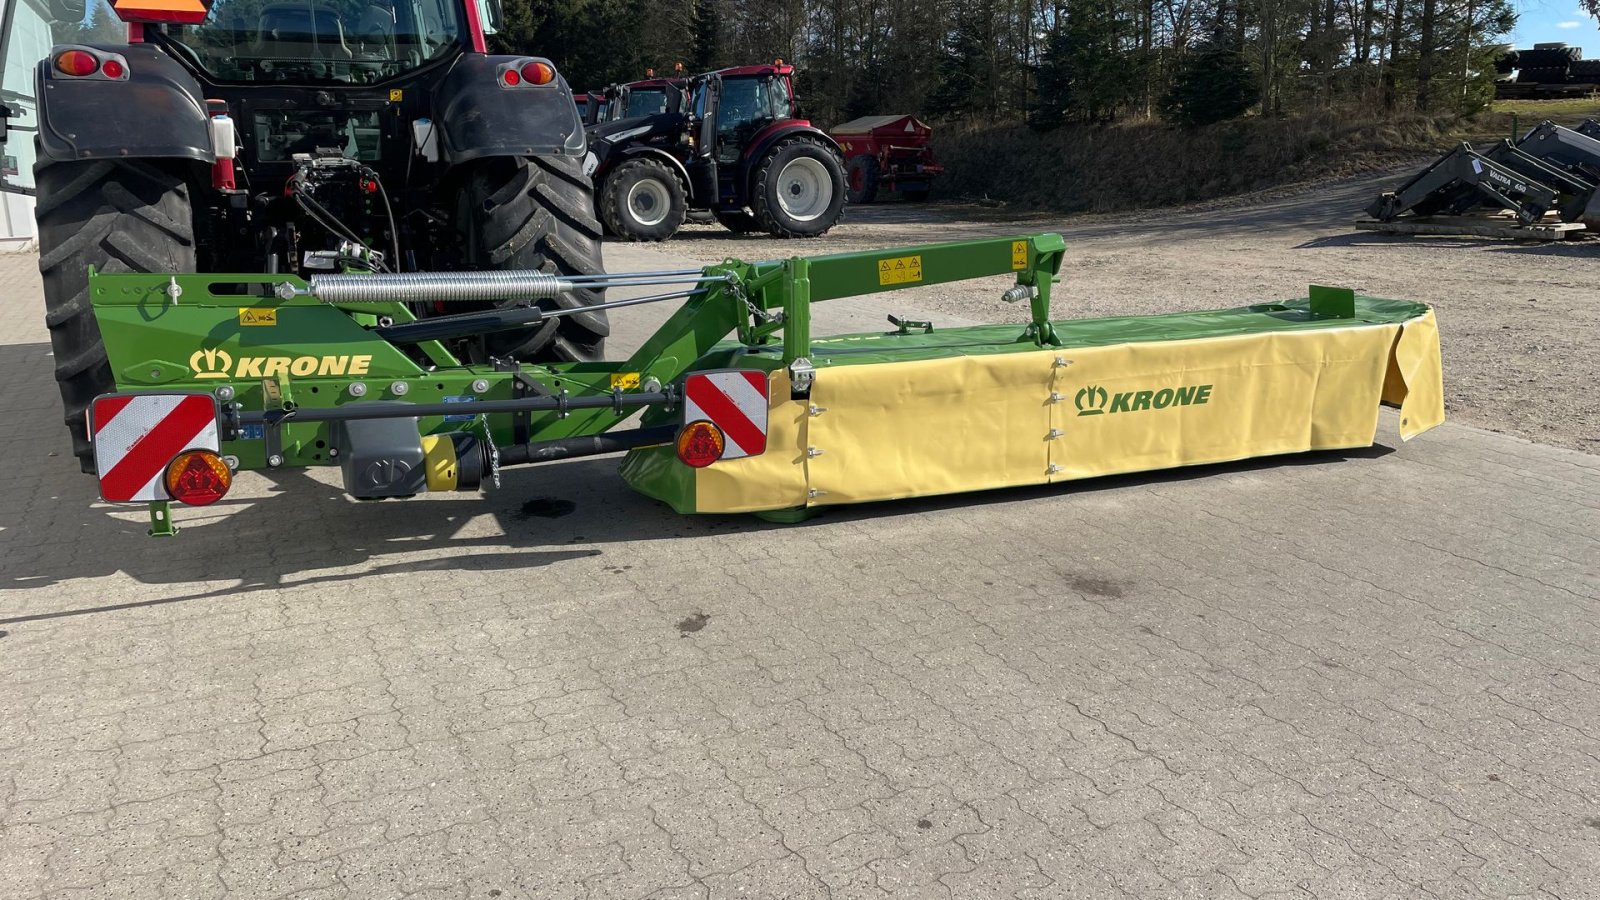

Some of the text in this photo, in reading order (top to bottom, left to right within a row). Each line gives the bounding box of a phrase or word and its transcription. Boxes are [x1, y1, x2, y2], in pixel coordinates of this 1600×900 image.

[1490, 170, 1527, 193] VALTRA 650
[235, 355, 372, 377] KRONE
[1109, 385, 1213, 413] KRONE
